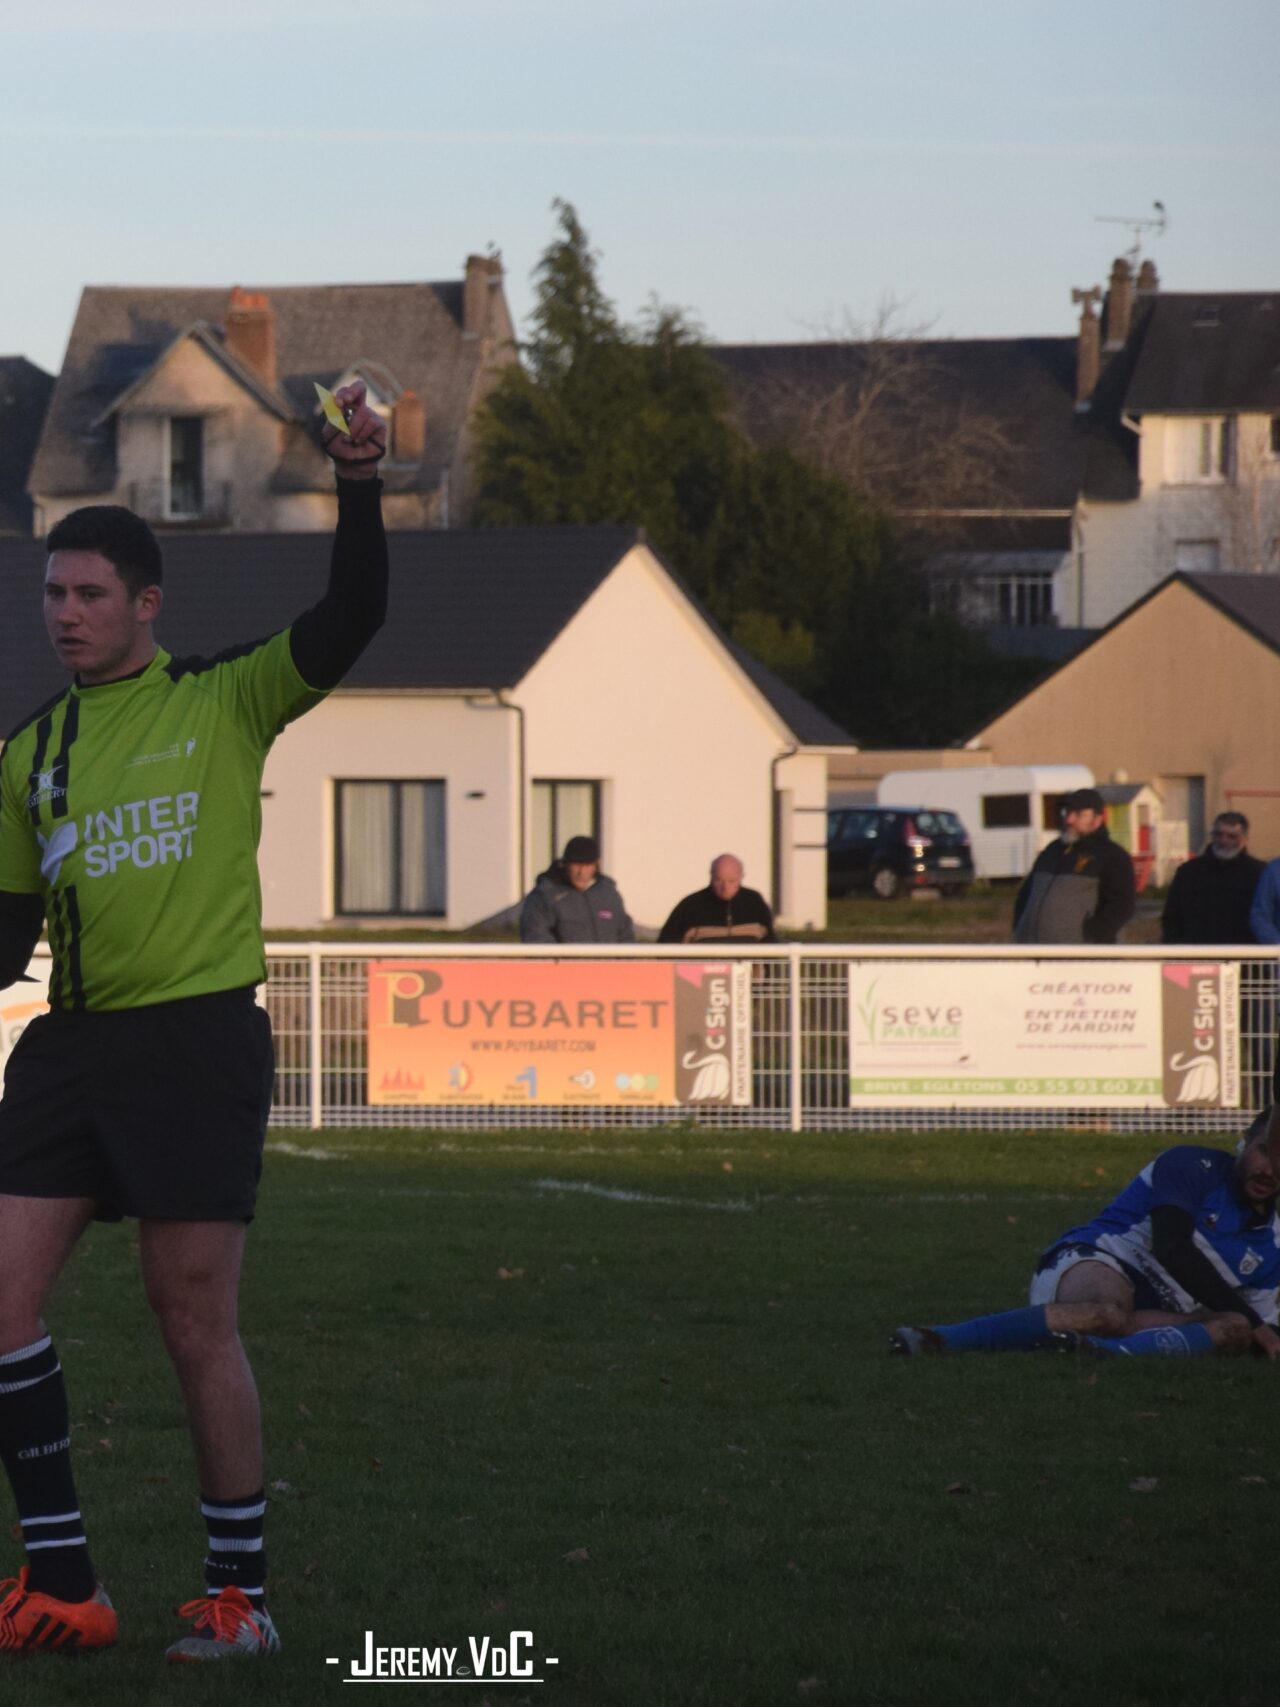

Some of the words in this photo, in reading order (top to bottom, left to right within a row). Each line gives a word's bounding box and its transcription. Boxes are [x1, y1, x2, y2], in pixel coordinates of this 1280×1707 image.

[84, 791, 199, 843] INTER
[84, 825, 197, 877] SPORT
[1028, 981, 1133, 995] CRÉATION
[375, 970, 669, 1030] PUYBARET
[1024, 1009, 1138, 1020] ENTRETIEN
[882, 1025, 962, 1038] PAYSAGE
[1026, 1022, 1053, 1033] DE
[1058, 1022, 1137, 1033] JARDIN
